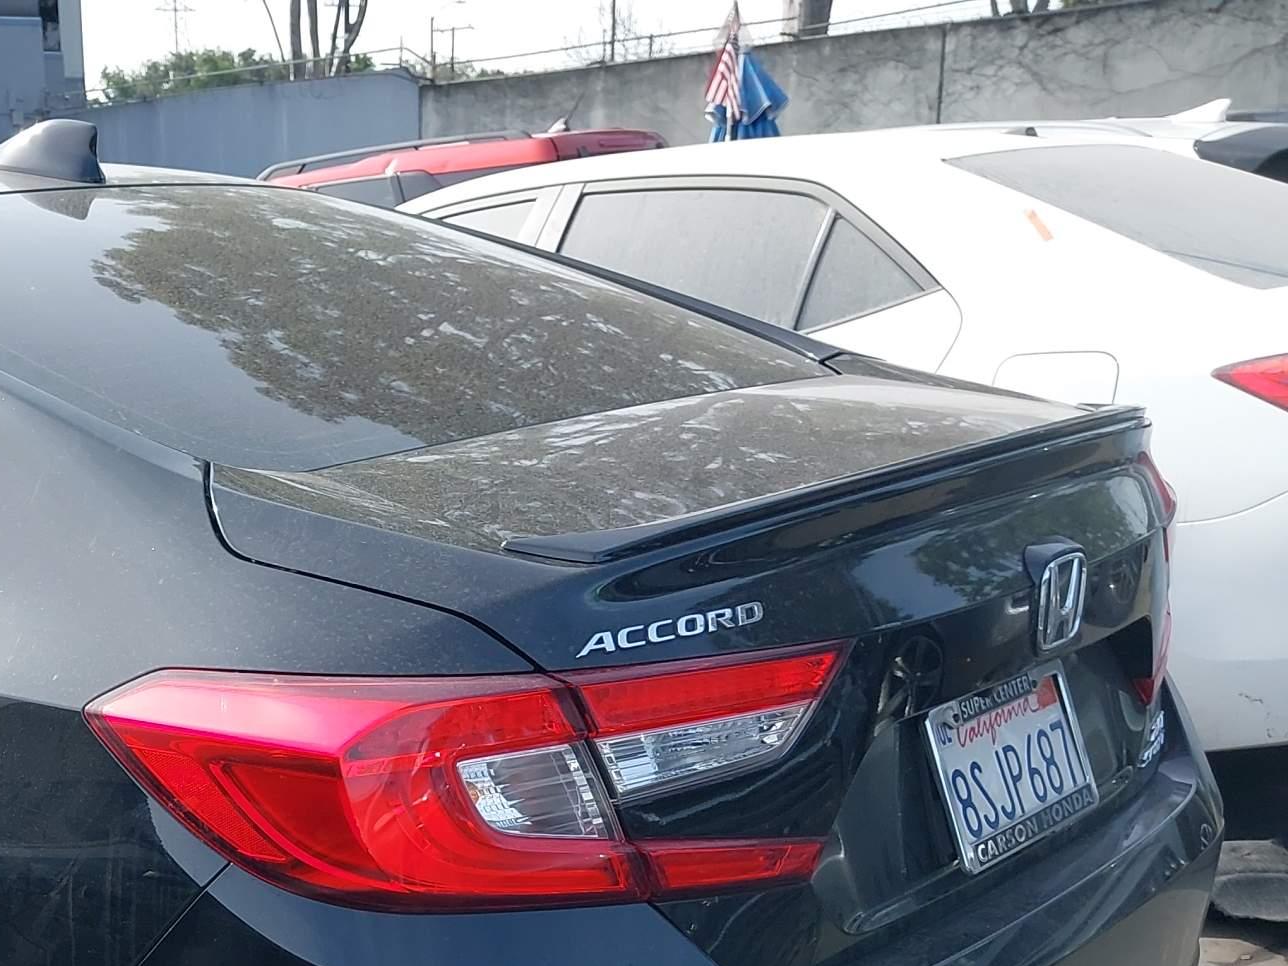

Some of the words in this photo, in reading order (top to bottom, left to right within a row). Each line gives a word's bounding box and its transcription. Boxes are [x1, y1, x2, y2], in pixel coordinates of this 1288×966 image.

[576, 601, 763, 658] ACCORD
[956, 697, 1040, 747] California
[961, 694, 995, 718] SUPER
[995, 675, 1031, 702] CENTER
[951, 719, 1078, 839] 8SJP687
[977, 820, 1038, 862] CARSON
[1041, 791, 1093, 829] HONDA
